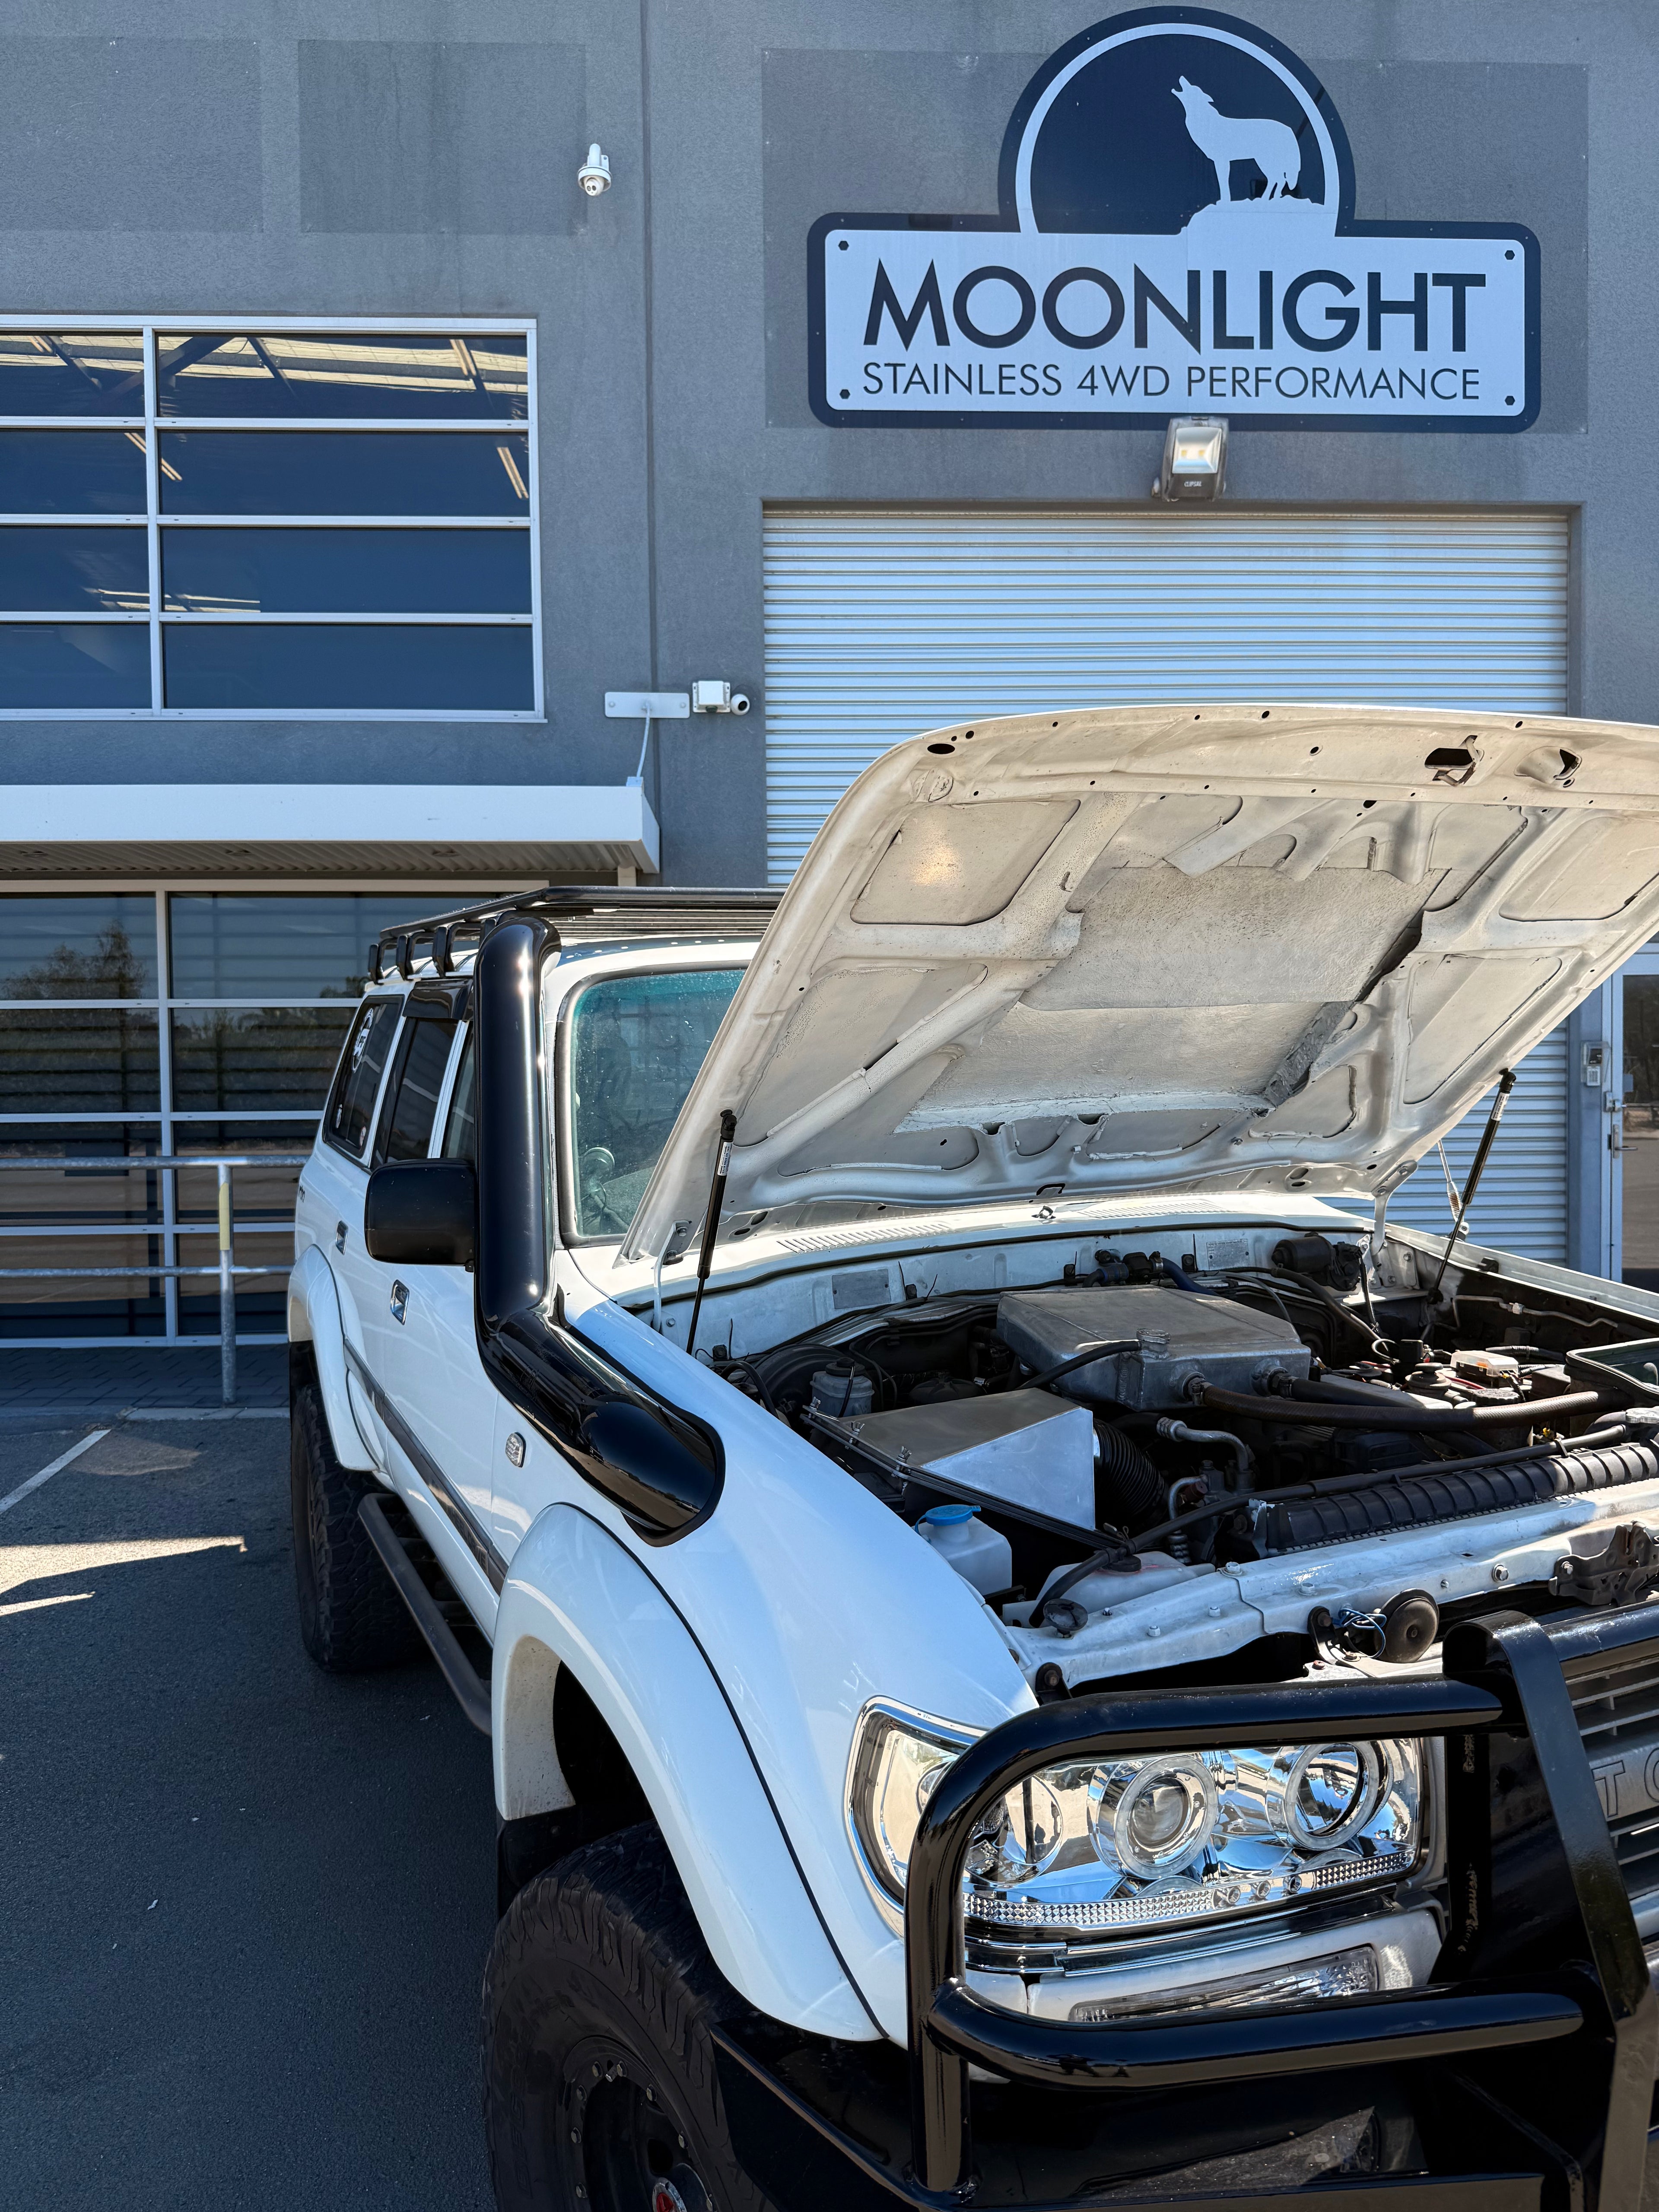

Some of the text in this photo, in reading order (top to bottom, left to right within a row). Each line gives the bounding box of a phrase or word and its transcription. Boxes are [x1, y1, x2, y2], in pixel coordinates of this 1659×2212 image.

[863, 258, 1486, 355] MOONLIGHT
[863, 362, 1479, 400] STAINLESS 4WD PERFORMANCE
